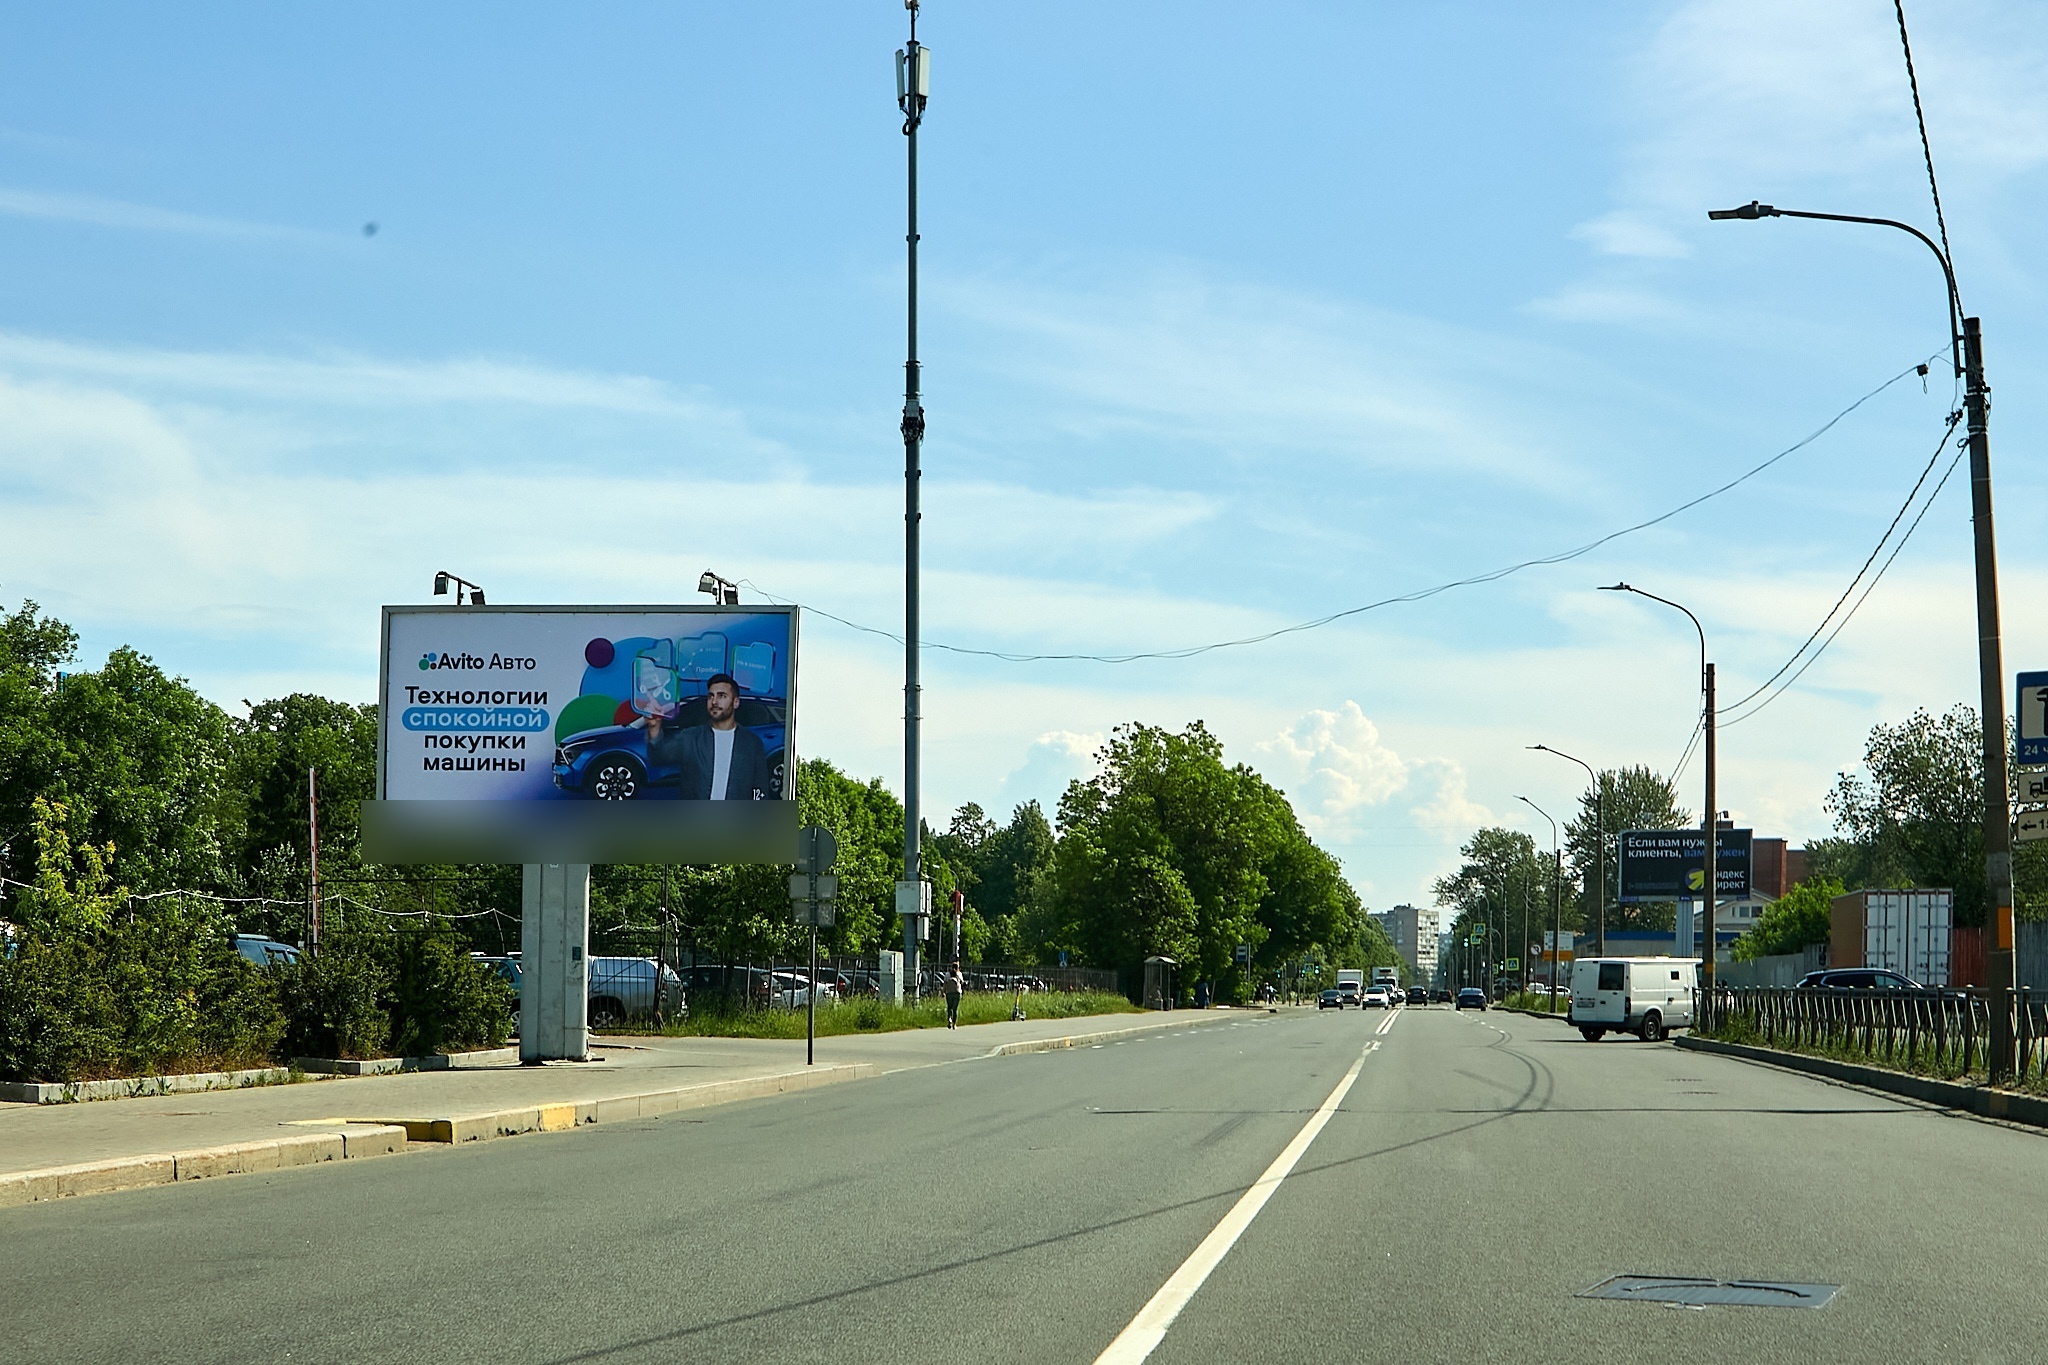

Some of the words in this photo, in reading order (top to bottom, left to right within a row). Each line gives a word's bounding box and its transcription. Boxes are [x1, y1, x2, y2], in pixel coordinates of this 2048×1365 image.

[438, 653, 485, 670] Avito
[489, 653, 536, 670] Авто
[405, 686, 548, 705] Технологии
[409, 707, 542, 727] спокойной
[424, 735, 526, 753] покупки
[2024, 744, 2038, 755] 24
[424, 757, 526, 771] машины
[1628, 838, 1656, 847] Если
[1658, 839, 1681, 847] вам
[1682, 839, 1722, 849] нужы
[1628, 849, 1682, 858] клиенты,
[1684, 849, 1705, 857] вам
[1716, 849, 1745, 858] ужен
[1716, 870, 1744, 880] ндекс
[1716, 881, 1745, 890] ирект
